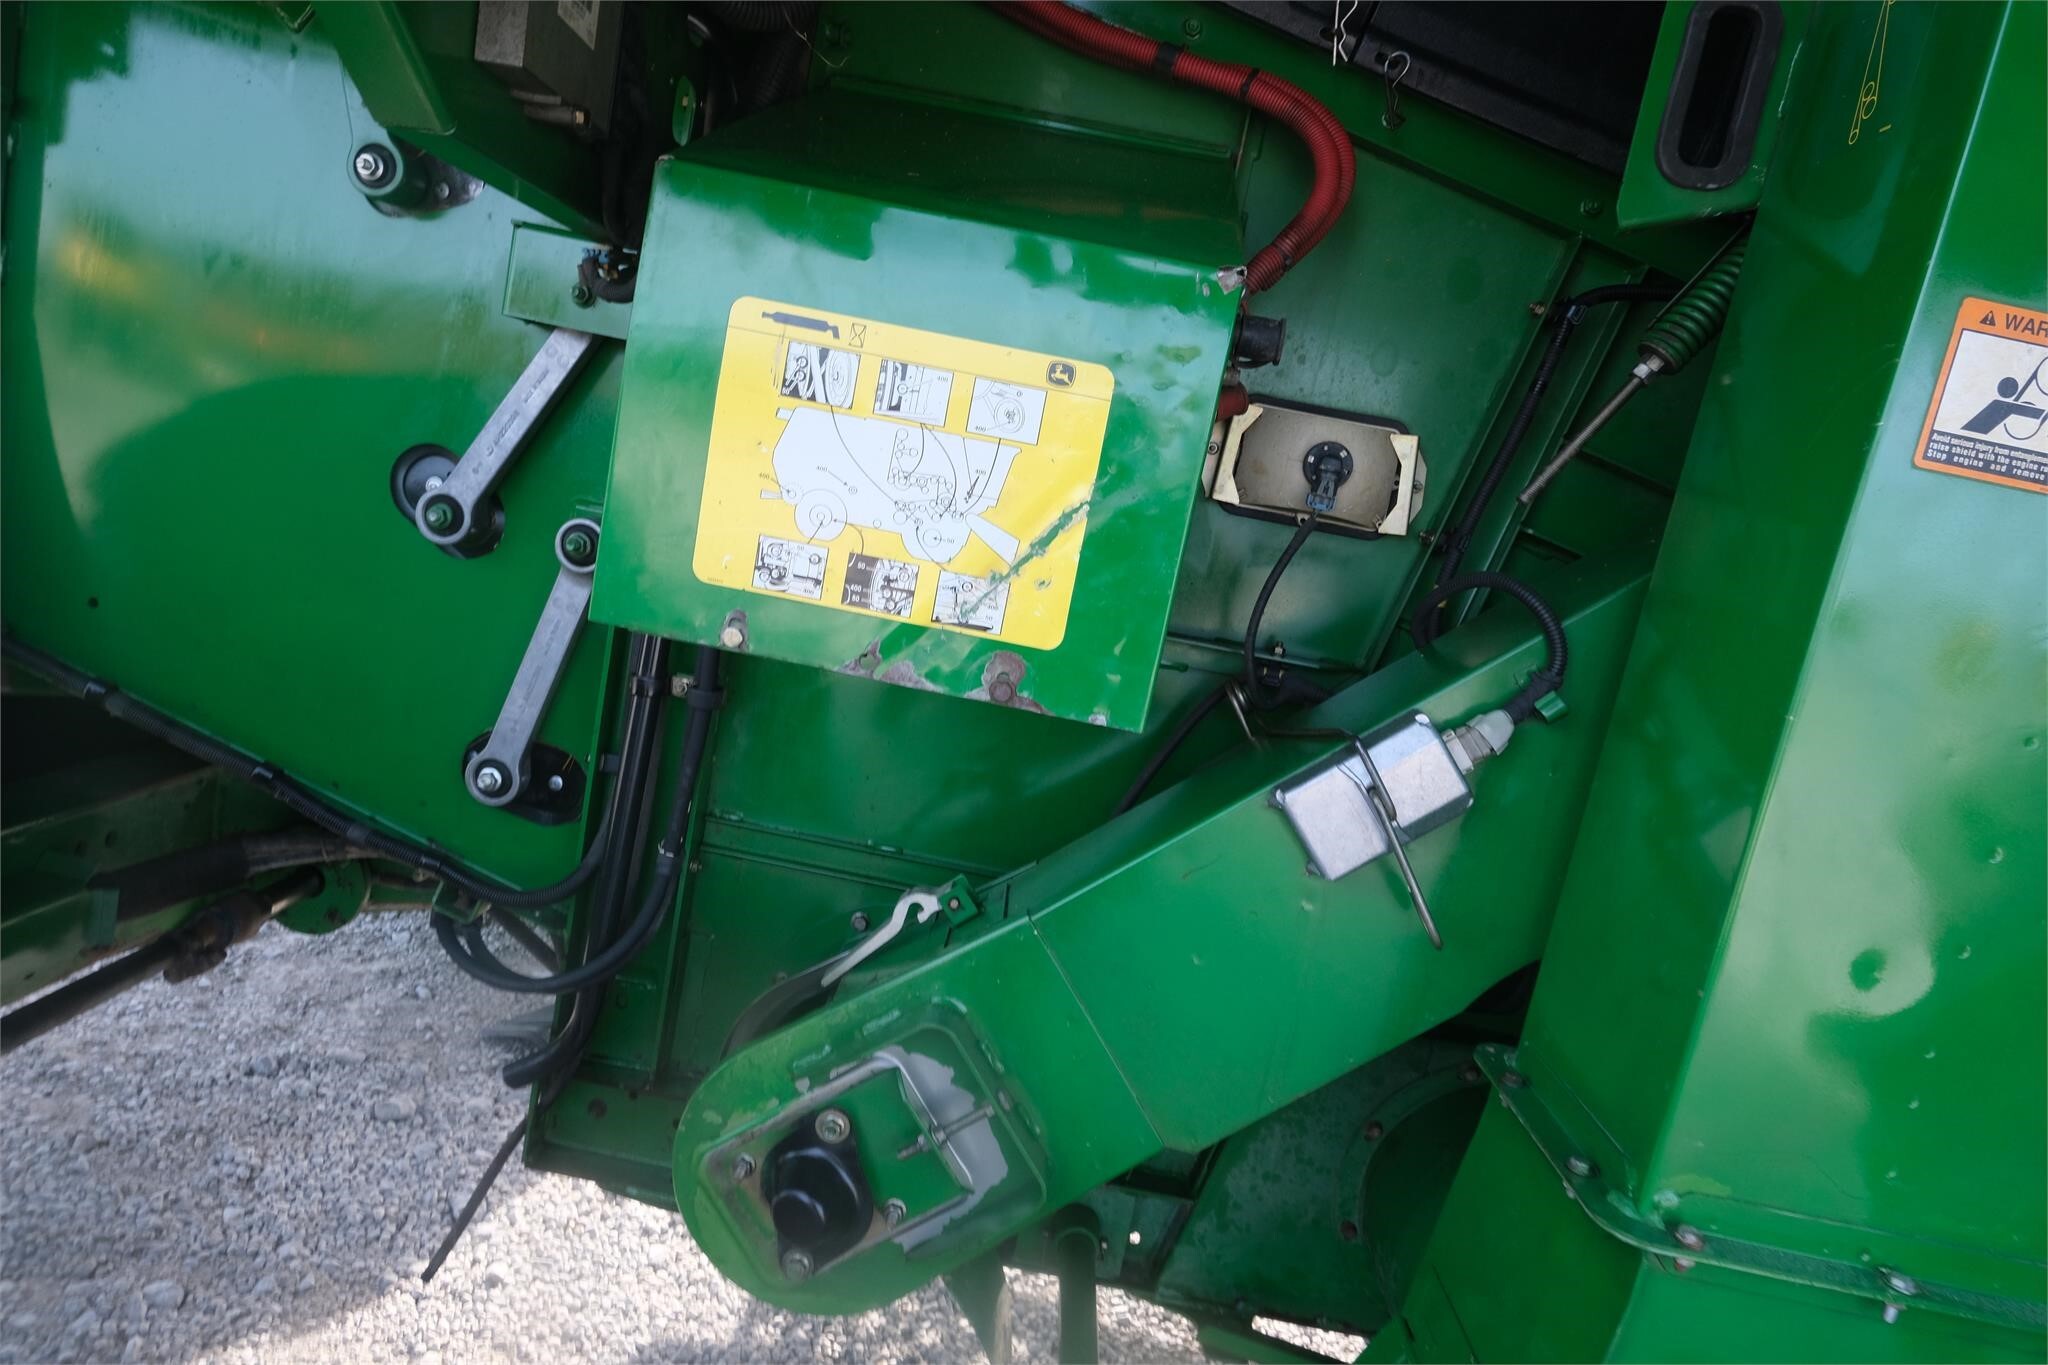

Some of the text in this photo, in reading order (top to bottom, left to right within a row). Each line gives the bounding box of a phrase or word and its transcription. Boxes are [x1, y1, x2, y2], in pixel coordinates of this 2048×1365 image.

[1927, 449, 2045, 480] Stop engine and remove
[1951, 445, 1977, 458] shield
[1978, 450, 1995, 461] with
[1997, 455, 2009, 465] the
